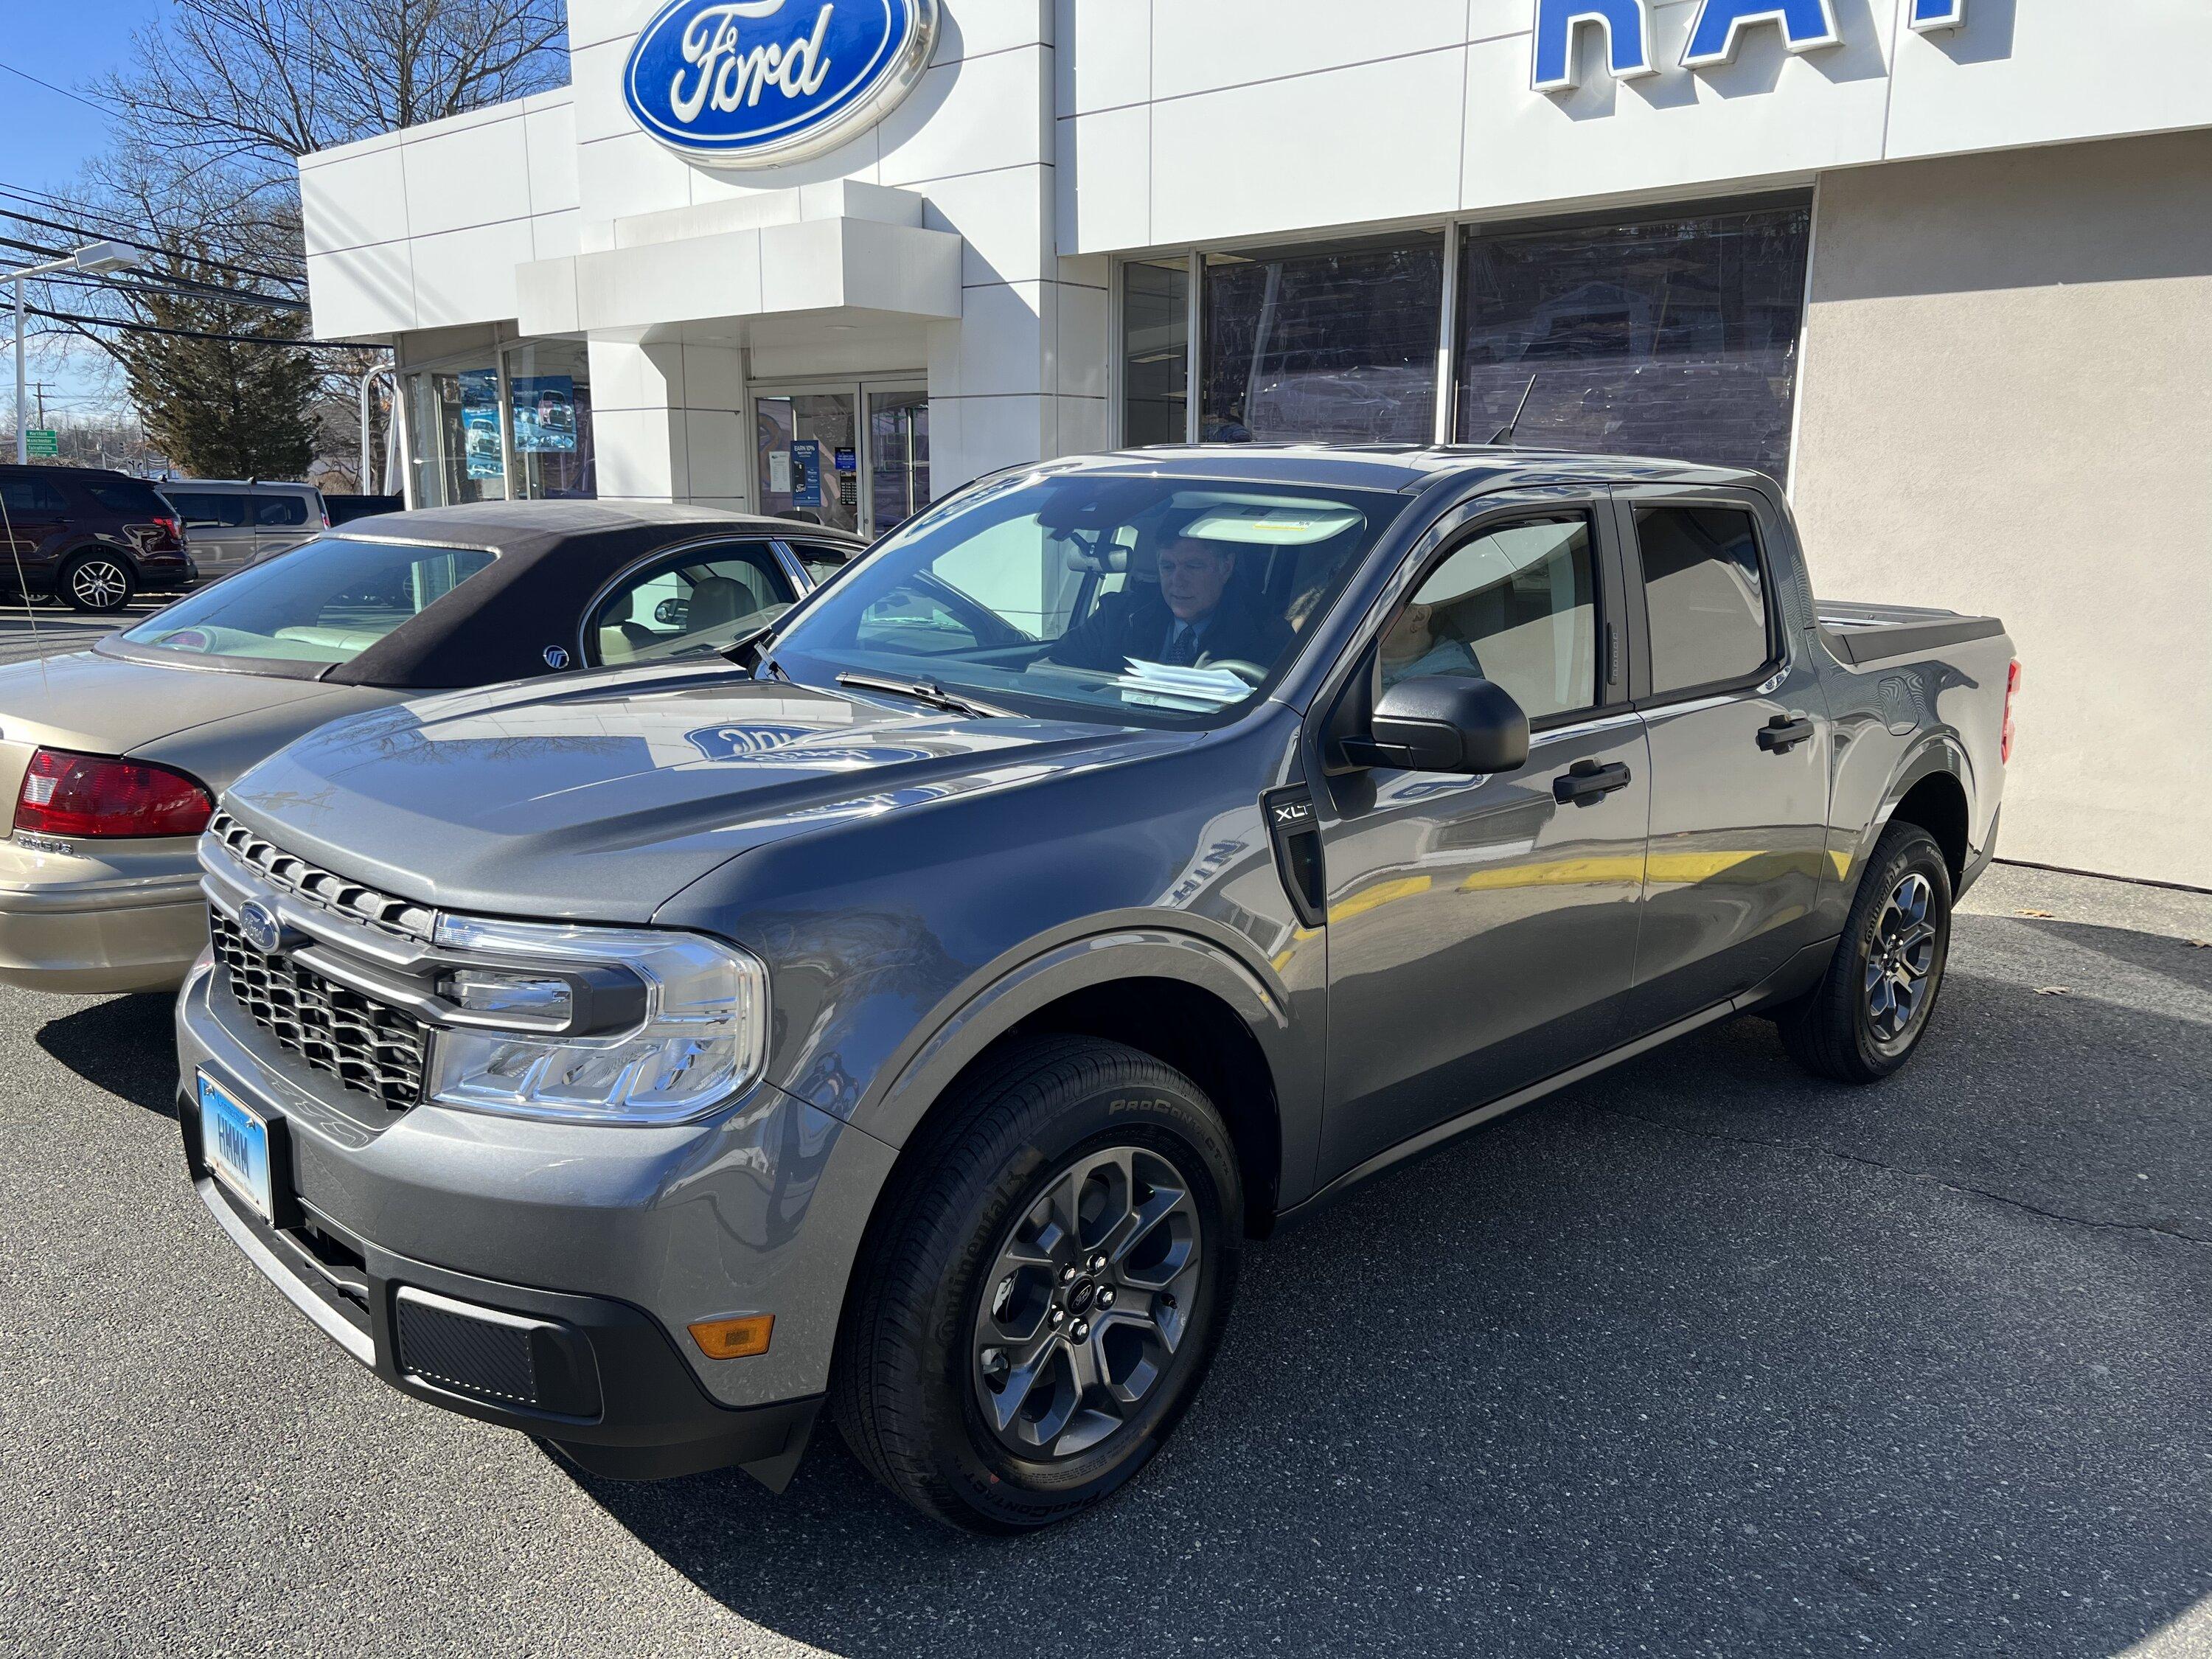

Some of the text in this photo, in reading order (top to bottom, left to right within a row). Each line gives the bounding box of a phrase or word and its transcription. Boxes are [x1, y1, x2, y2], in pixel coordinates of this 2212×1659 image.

[670, 0, 834, 124] Ford
[796, 484, 806, 493] Ford
[1276, 803, 1312, 822] XLT
[240, 912, 267, 944] Ford
